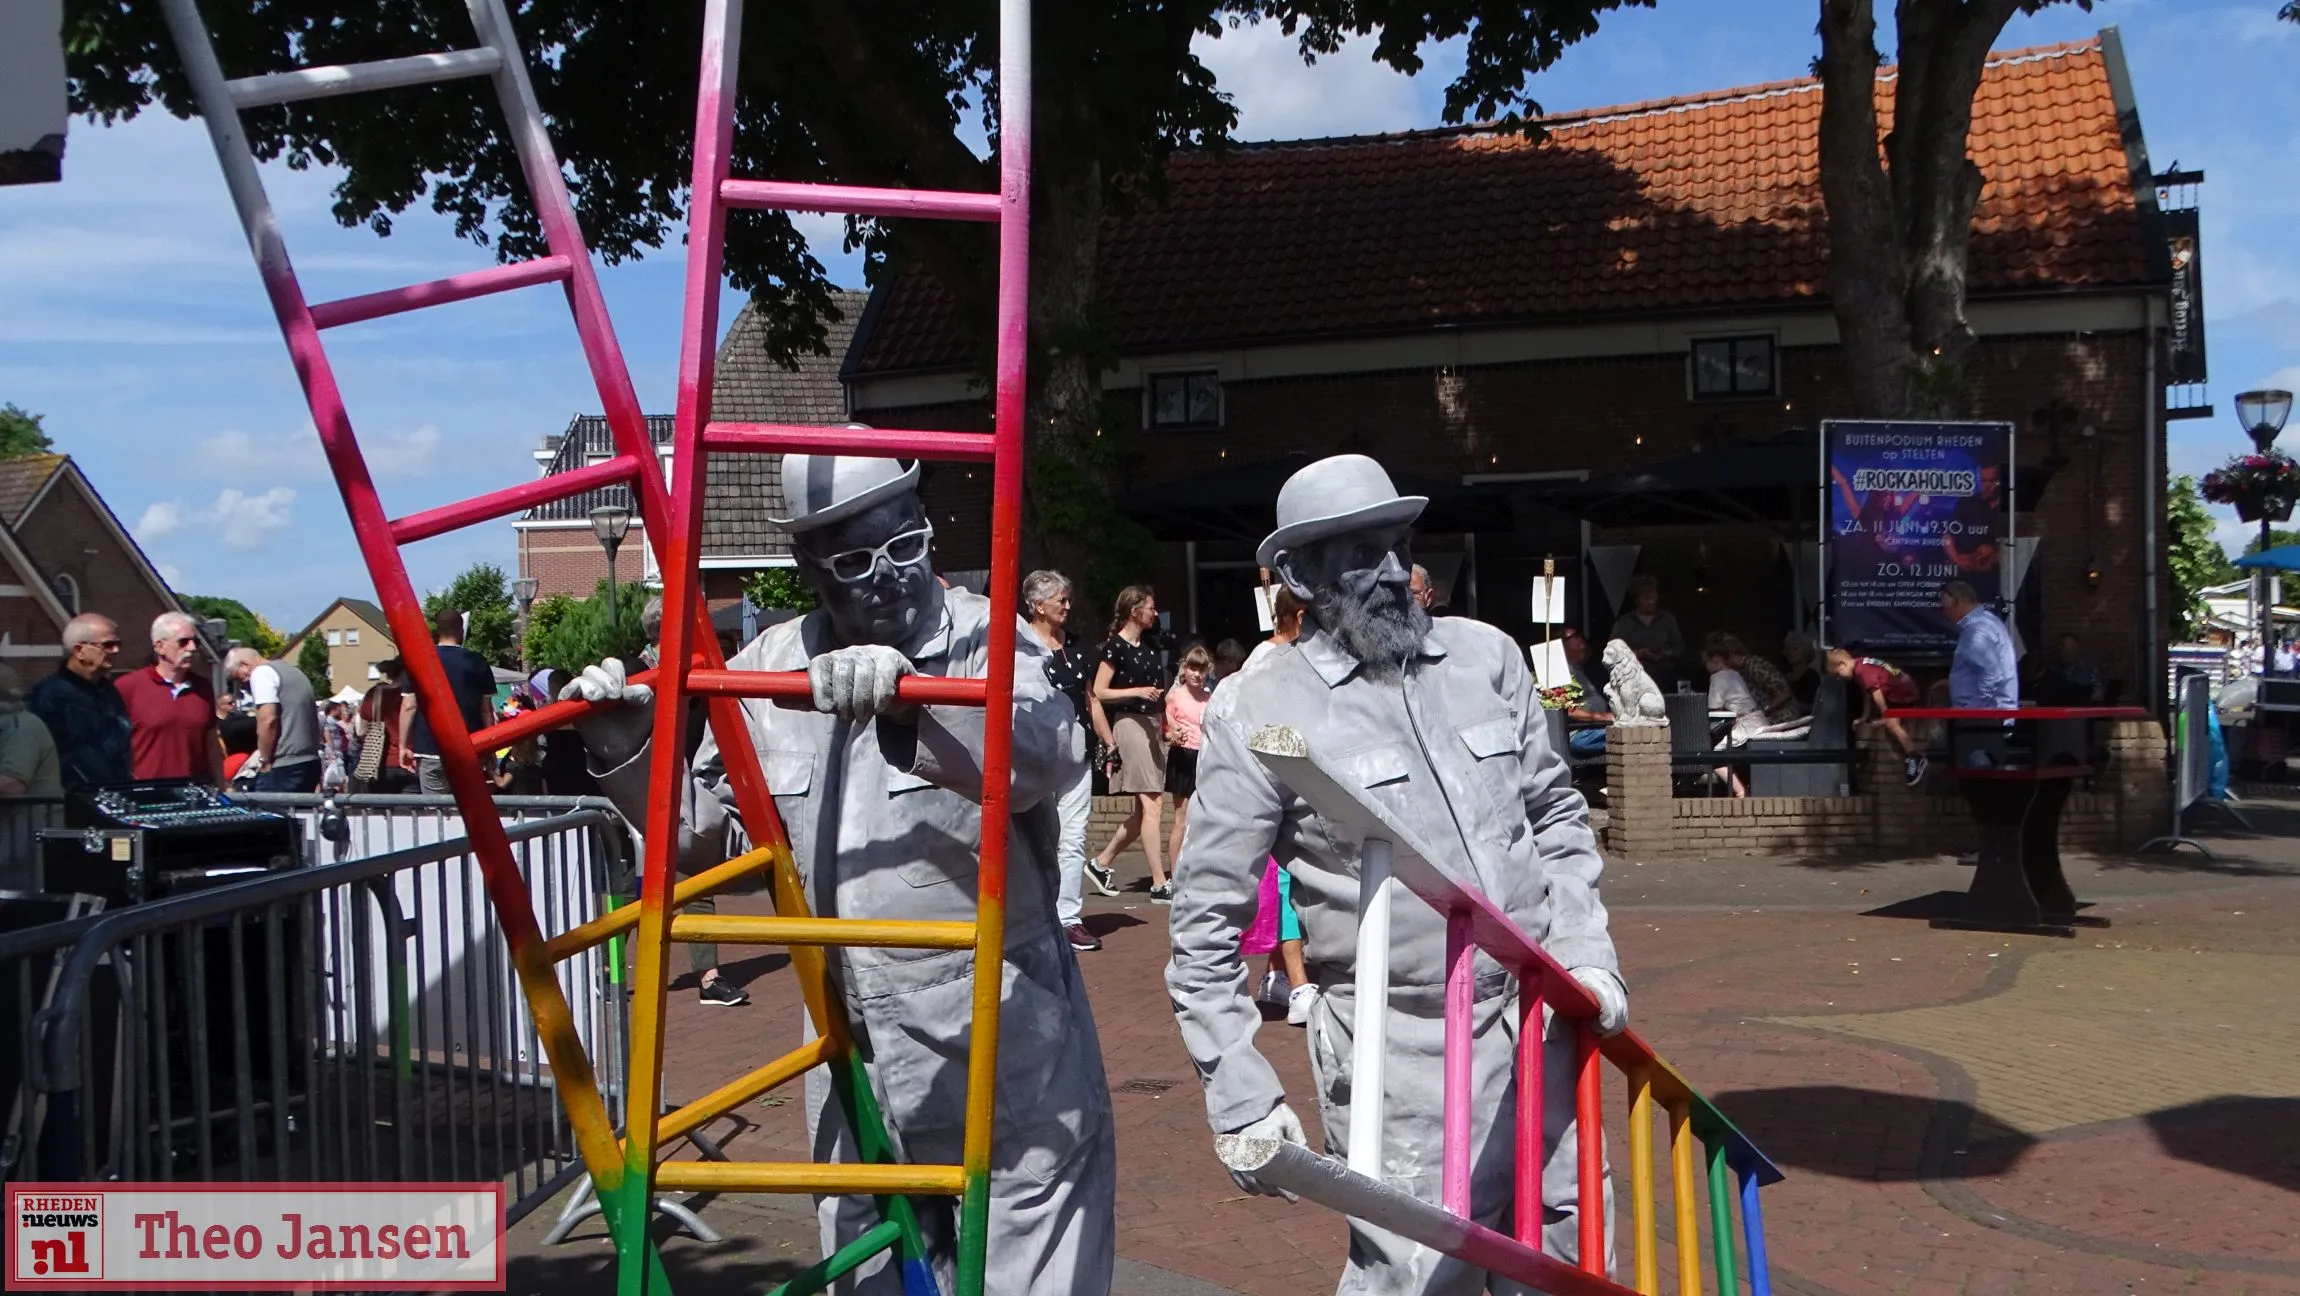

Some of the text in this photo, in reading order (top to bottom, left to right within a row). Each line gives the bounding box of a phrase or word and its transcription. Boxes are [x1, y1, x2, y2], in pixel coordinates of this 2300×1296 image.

[1845, 434, 1983, 447] BUITENPODIUM RHEDEN
[1882, 449, 1945, 460] op STELTEN
[1855, 471, 1974, 491] #ROCKAHOLICS
[1844, 520, 1867, 533] ZA.
[1885, 538, 1920, 546] CENTRUM
[1877, 563, 1958, 577] ZO. 12 JUNI
